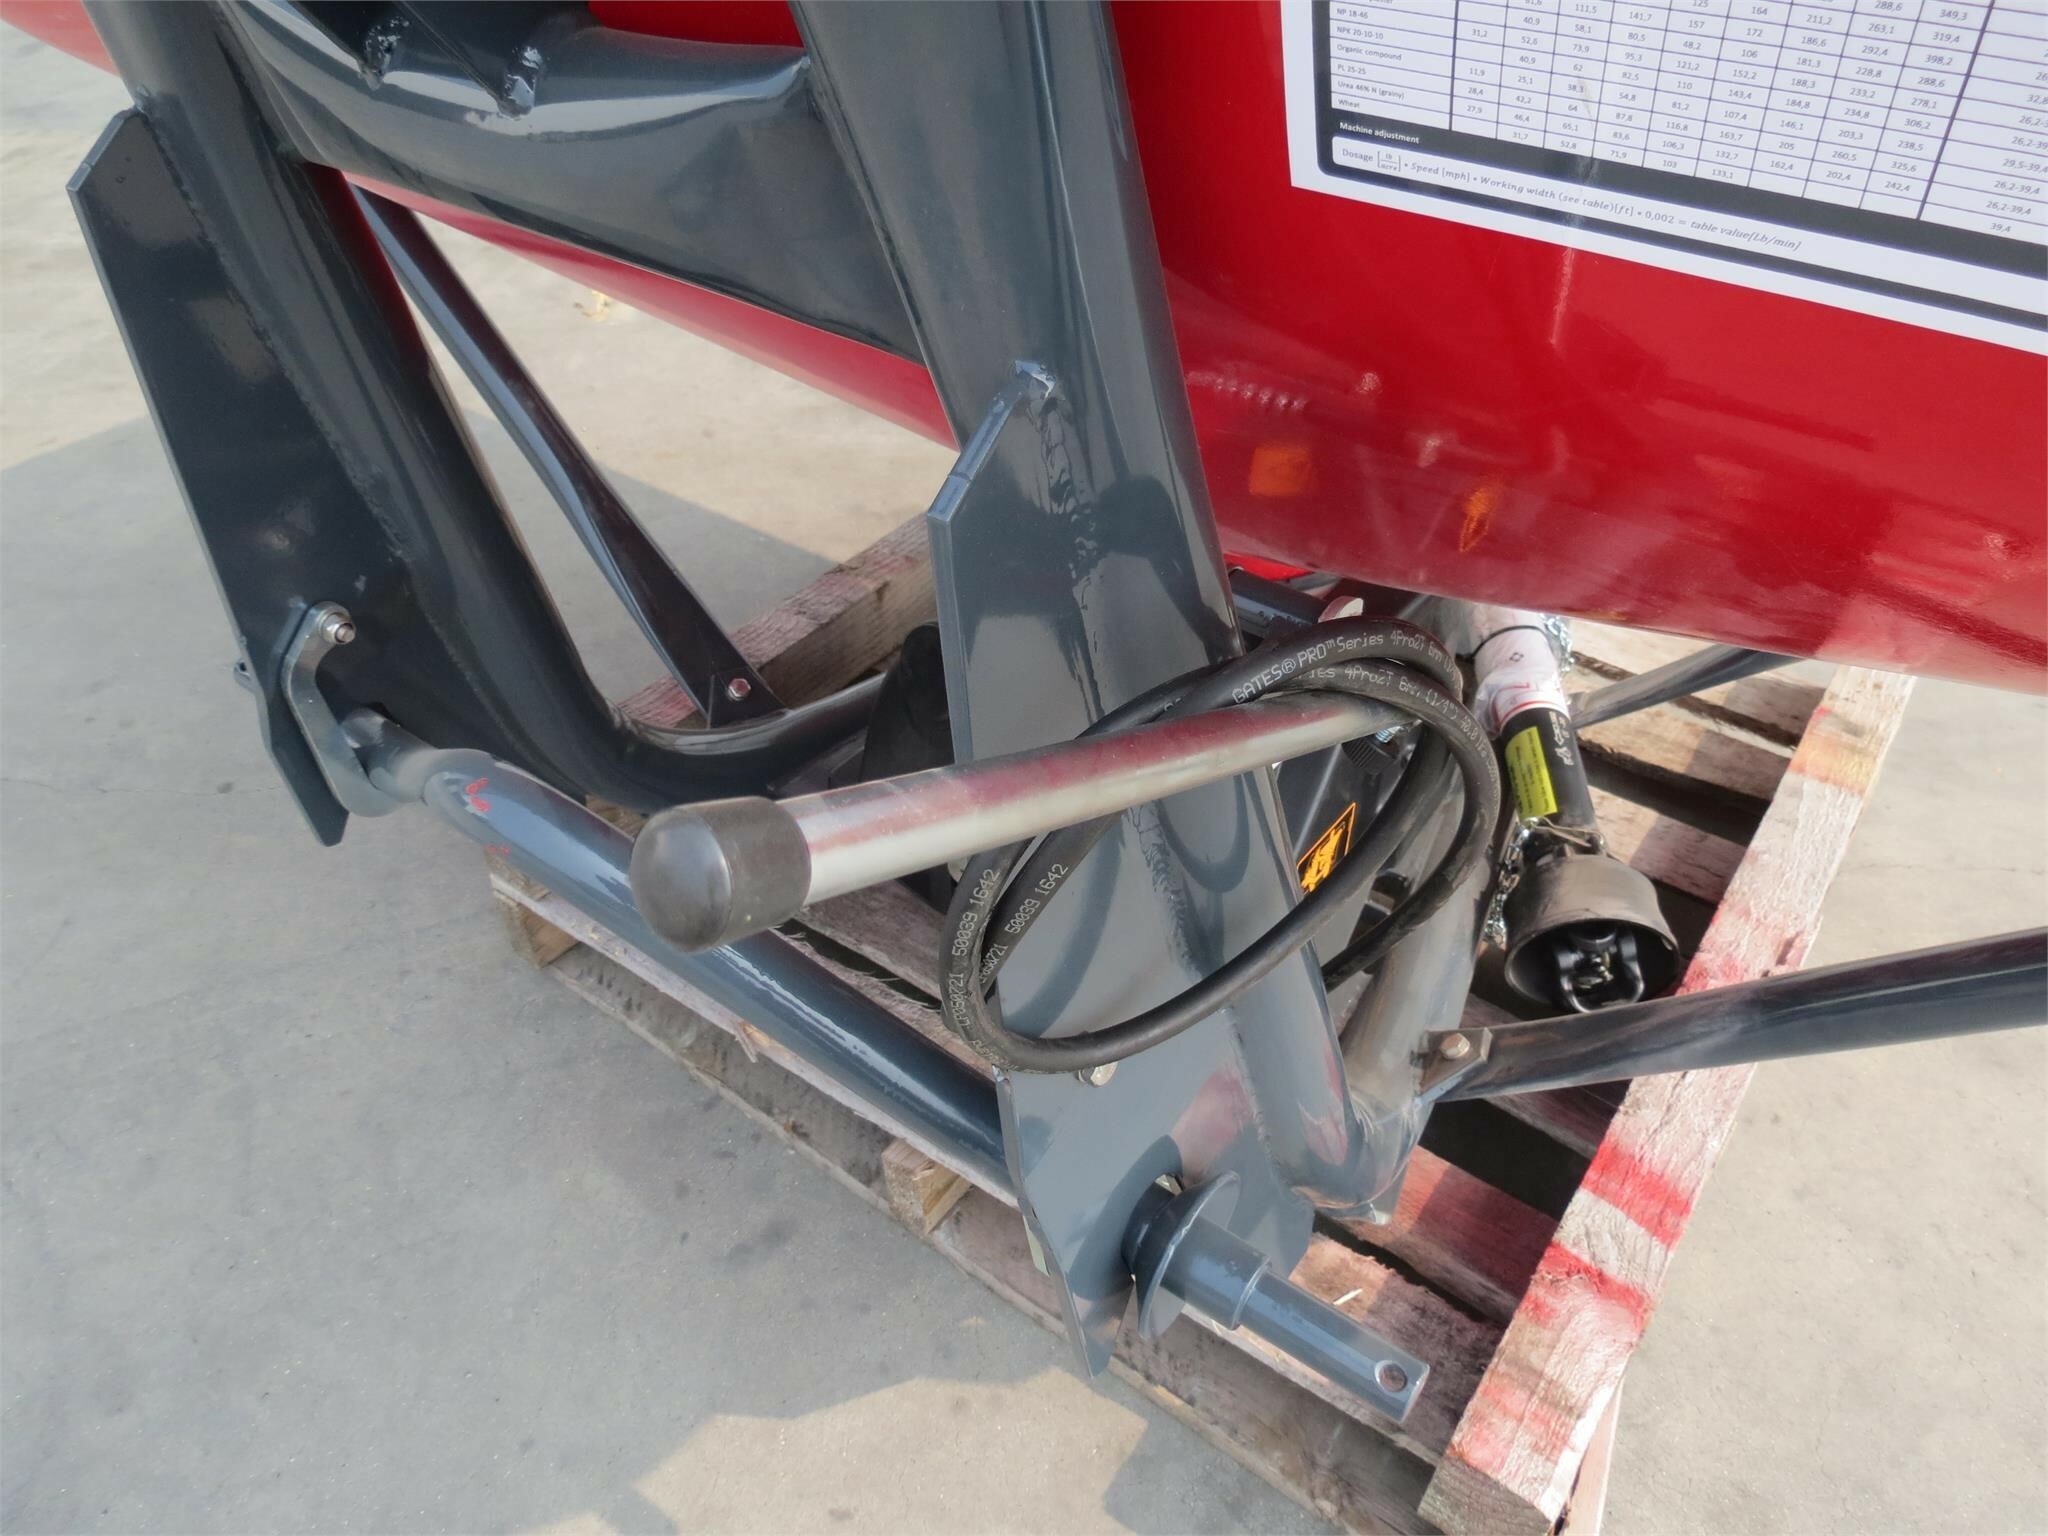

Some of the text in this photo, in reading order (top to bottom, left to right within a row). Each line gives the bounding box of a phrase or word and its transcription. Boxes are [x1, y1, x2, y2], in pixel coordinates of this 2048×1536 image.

[1353, 28, 1384, 40] 20-10-10
[1336, 44, 1403, 61] Organic compound
[1338, 99, 1360, 108] Wheat
[1339, 122, 1420, 144] Machine adjustment
[1341, 148, 1373, 162] Dosage
[1411, 162, 1439, 174] Speed
[1442, 167, 1470, 183] [mph]
[1480, 176, 1525, 194] Working
[1526, 187, 1555, 200] width
[1558, 192, 1580, 205] (see
[1645, 210, 1675, 224] 0,002
[1690, 221, 1719, 234] table
[1004, 898, 1041, 934] 50039
[1034, 863, 1069, 896] 1642
[952, 911, 978, 957] 50039
[969, 868, 1000, 907] 1642
